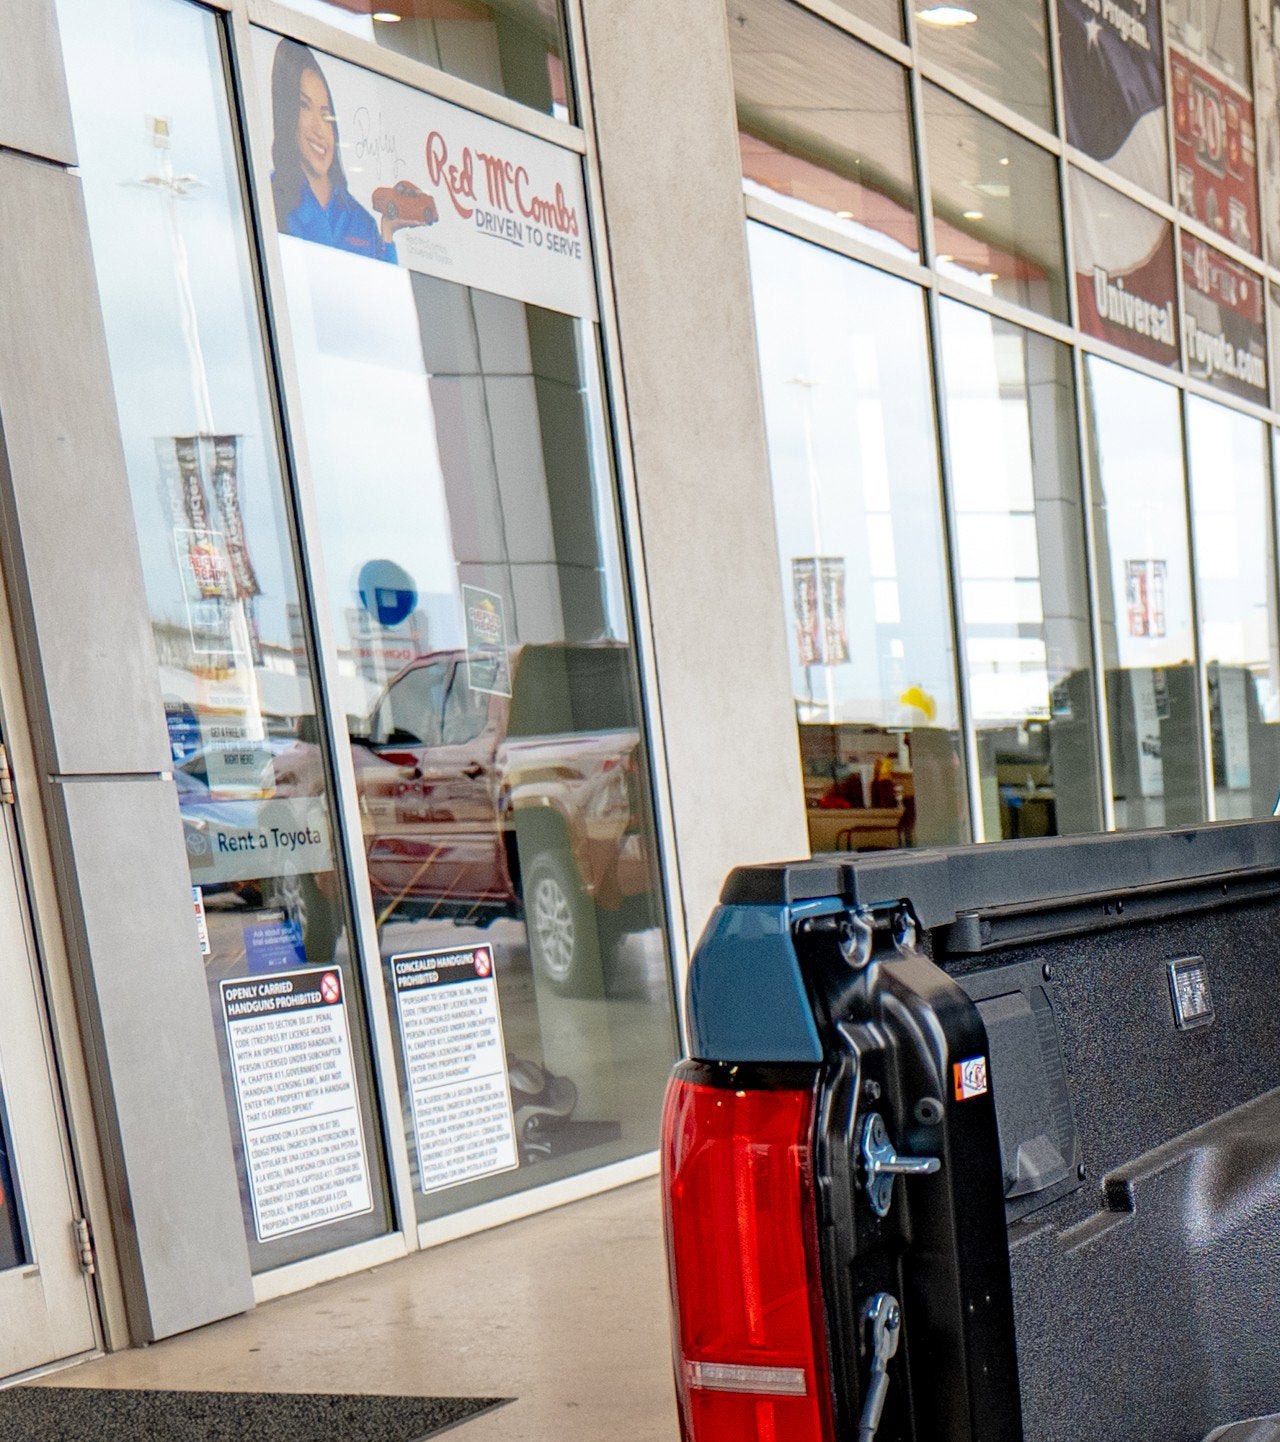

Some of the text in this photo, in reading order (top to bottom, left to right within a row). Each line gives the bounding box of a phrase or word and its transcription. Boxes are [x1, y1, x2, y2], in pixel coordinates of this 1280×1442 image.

[426, 131, 579, 237] Red McCombs
[475, 209, 582, 259] DRIVEN TO SERVE
[1093, 264, 1176, 346] Universal
[1184, 313, 1267, 389] Toyota.com
[217, 827, 321, 855] Rent a Toyota
[396, 953, 474, 974] CONCEALED HANDGUNS
[398, 972, 438, 987] PROHIBITED
[226, 981, 293, 1000] OPENLY CARRIED
[228, 992, 321, 1015] HANDGUNS PROHIBITED
[275, 1019, 298, 1029] SECTION
[289, 1028, 309, 1039] LICENSE
[311, 1025, 331, 1035] HOLDER
[237, 1051, 252, 1060] WITH
[284, 1041, 307, 1052] CARRIED
[239, 1063, 261, 1073] PERSON
[244, 1100, 262, 1111] ENTER
[246, 1112, 260, 1122] THAT
[268, 1106, 291, 1118] CARRIED
